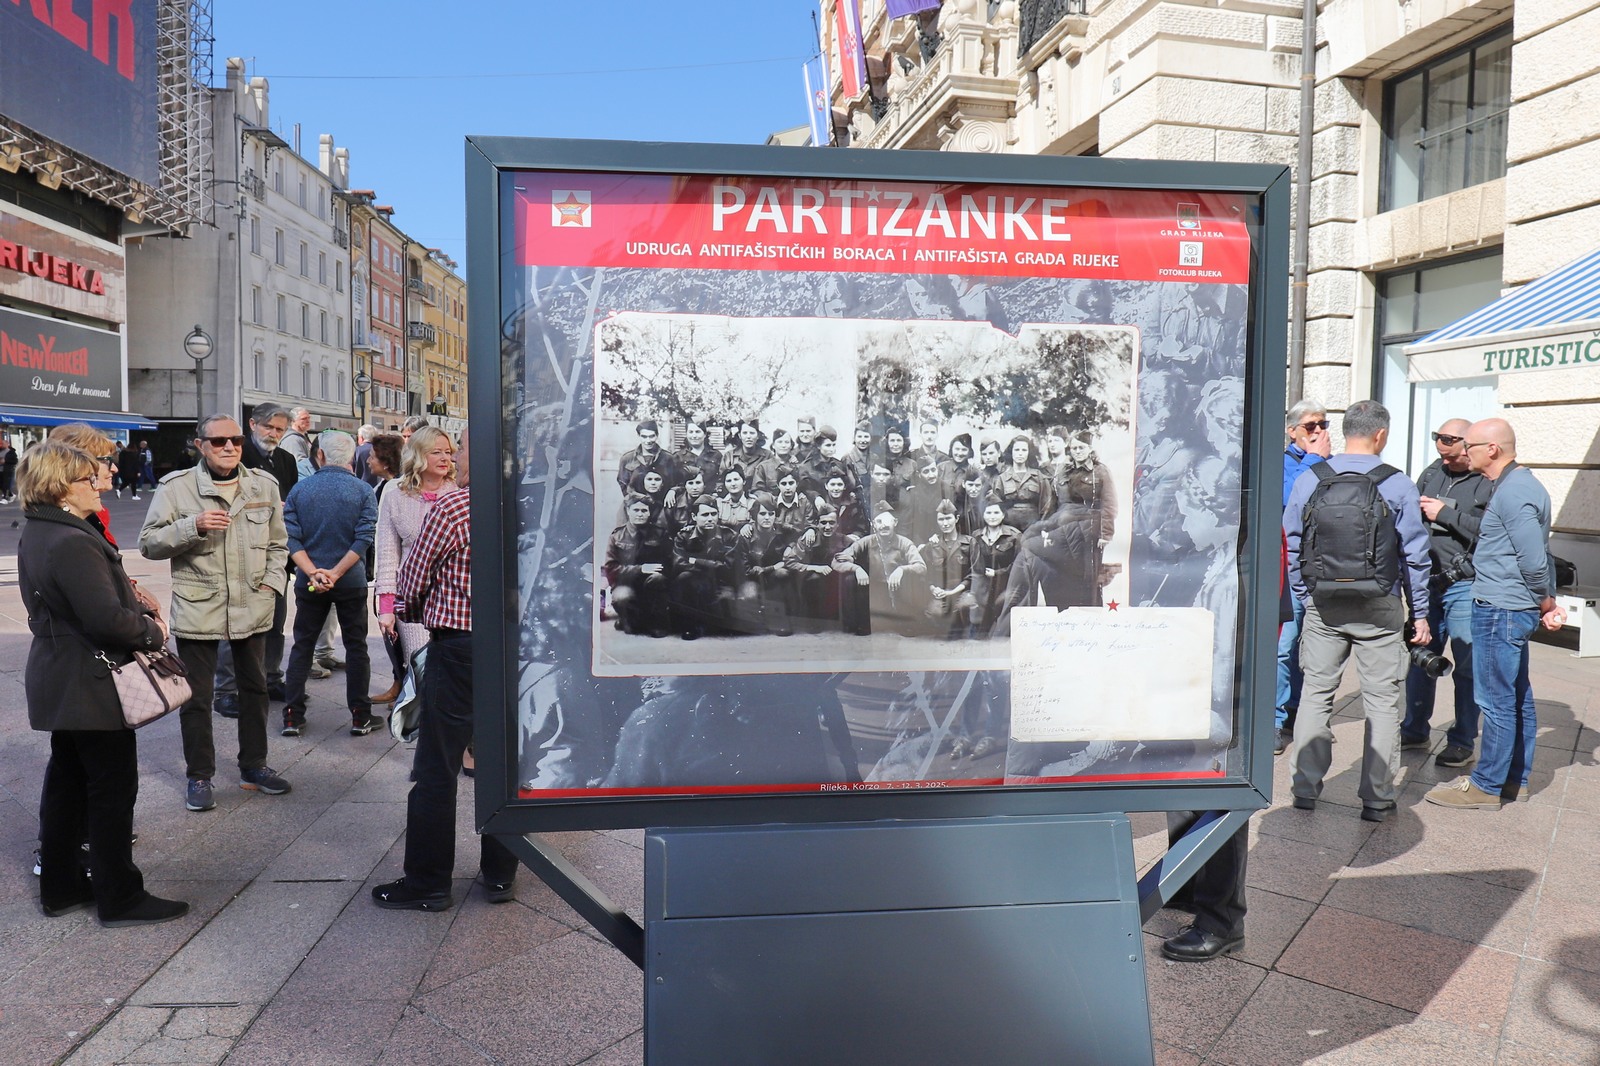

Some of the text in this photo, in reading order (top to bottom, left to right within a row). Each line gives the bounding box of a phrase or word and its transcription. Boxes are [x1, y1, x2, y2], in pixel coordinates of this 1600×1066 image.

[626, 241, 1120, 268] UDRUGA ANTIFAŠISTIČKIH BORACA I ANTIFAŠISTA GRADA RIJEKE
[0, 238, 106, 296] RIJEKA
[1158, 268, 1223, 278] FOTOKLUB RIJEKA
[31, 375, 111, 399] Dress for the moment.
[853, 782, 880, 791] Korzo
